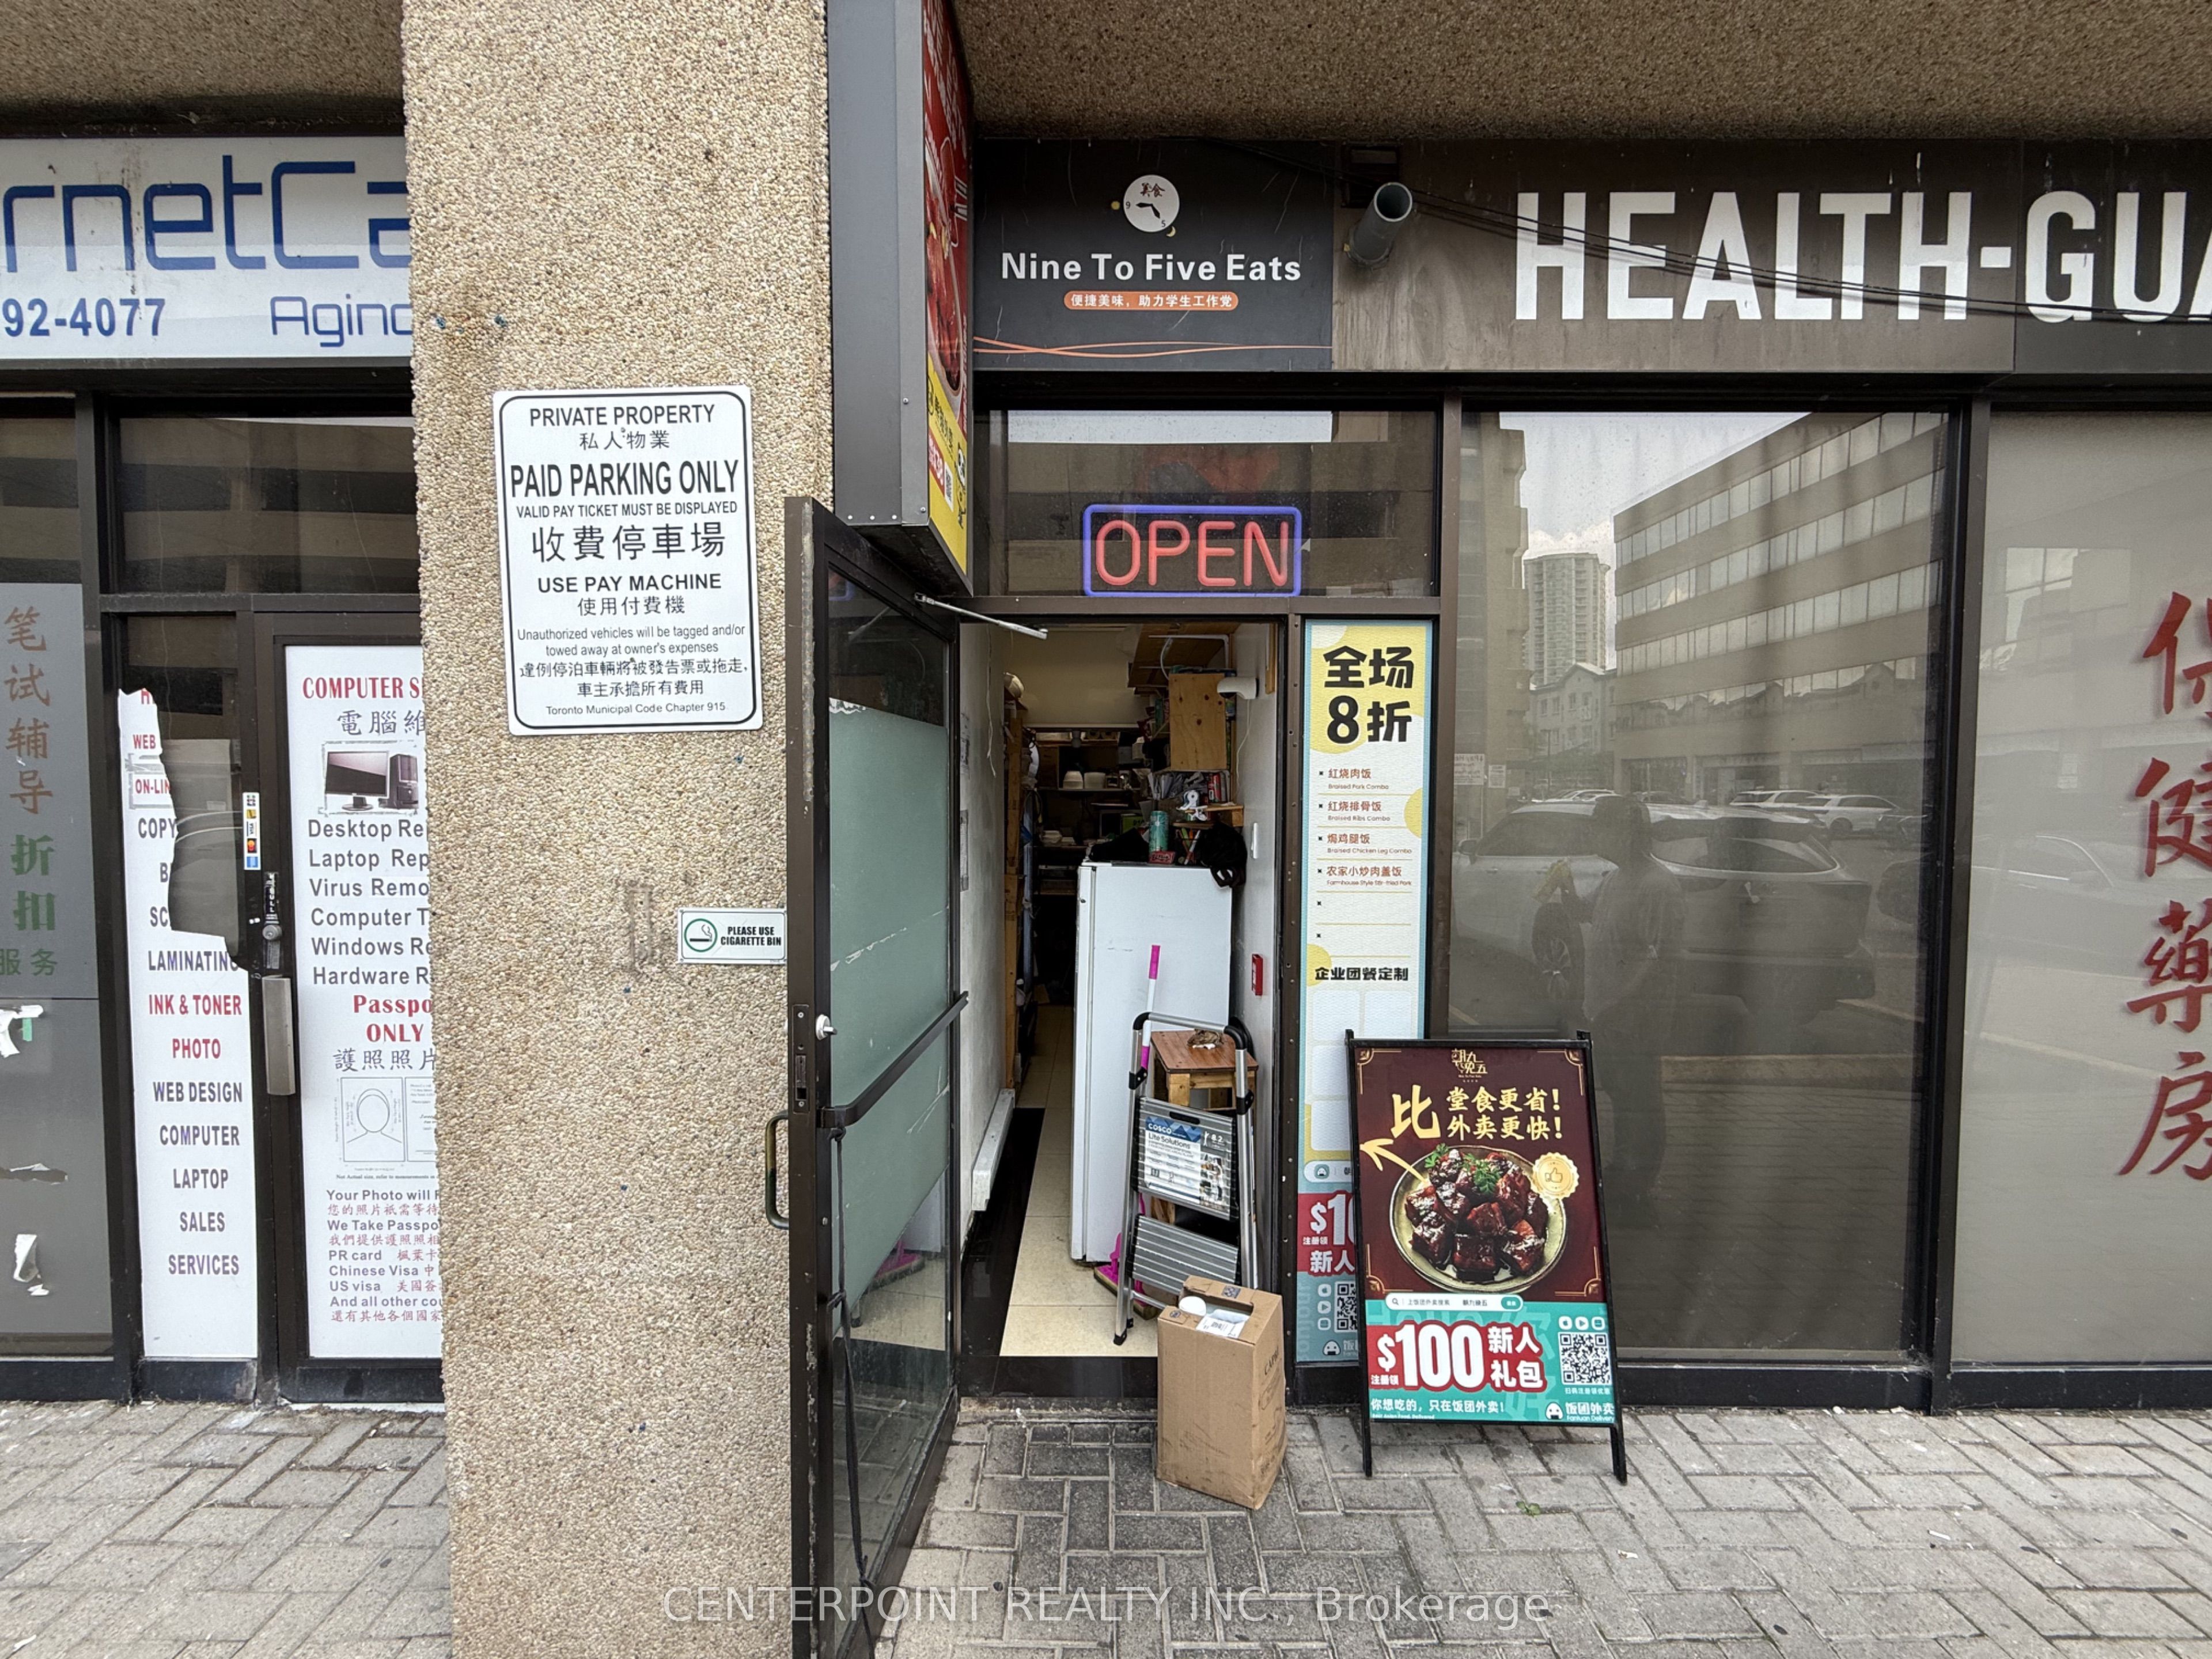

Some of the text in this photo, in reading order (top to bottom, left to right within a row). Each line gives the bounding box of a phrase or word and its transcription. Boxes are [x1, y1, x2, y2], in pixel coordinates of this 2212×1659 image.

[1125, 201, 1131, 209] 9
[1002, 252, 1301, 281] Nine To Five Eats
[1070, 294, 1232, 308] 便捷美味，助力学生工作党
[2, 298, 166, 336] 92-4077
[530, 404, 715, 427] PRIVATE PROPERTY
[579, 430, 670, 451] 私人物業
[511, 460, 738, 498] PAID PARKING ONLY
[516, 501, 737, 518] VALID PAY TICKET MUST BE DISPLAYED
[532, 521, 725, 563] 收費停車場
[1096, 519, 1289, 587] OPEN
[538, 573, 722, 593] USE PAY MACHINE
[577, 595, 685, 616] 使用付費機
[517, 623, 745, 641] Unauthorized vehicles will be tagged and/or
[546, 642, 719, 658] towed away at owner's expenses
[1323, 645, 1415, 688] 全场
[302, 677, 423, 699] COMPUTER S
[577, 680, 704, 699] 車主承擔所有費用
[546, 701, 726, 717] Toronto Municipal Code Chapter 915
[1327, 695, 1412, 744] 8折
[337, 709, 425, 736] 電腦維
[132, 734, 156, 749] WEB
[1328, 768, 1371, 779] 红烧肉饭
[1327, 801, 1382, 812] 红烧排骨饭
[138, 818, 177, 839] COPY
[308, 819, 392, 842] Desktop
[309, 849, 380, 872] Laptop
[1326, 865, 1402, 877] 农家小炒肉盖饭
[10, 834, 56, 931] 折扣
[309, 877, 430, 896] Virus Remo
[310, 907, 412, 930] Computer
[727, 926, 775, 935] PLEASE USE
[311, 937, 404, 956] Windows
[720, 937, 781, 946] CIGARETTE BIN
[313, 966, 410, 985] Hardware
[1315, 967, 1409, 982] 企业团餐定制
[148, 995, 243, 1016] INK & TONER
[353, 994, 432, 1018] Passpo
[366, 1023, 424, 1043] ONLY
[172, 1039, 221, 1059] PHOTO
[332, 1047, 437, 1073] 護照照片
[153, 1081, 243, 1103] WEB DESIGN
[1446, 1086, 1560, 1113] 堂食更省！
[1390, 1084, 1441, 1139] 比
[159, 1125, 240, 1146] COMPUTER
[1148, 1123, 1172, 1134] COSCO
[1446, 1113, 1563, 1141] 外卖更快！
[1148, 1132, 1160, 1141] Lite
[1161, 1135, 1191, 1149] Solutions
[173, 1168, 229, 1189] LAPTOP
[326, 1190, 358, 1201] Your
[362, 1189, 403, 1201] Photo
[406, 1190, 430, 1201] will
[179, 1211, 225, 1232] SALES
[327, 1219, 438, 1233] We Take Passpo
[168, 1254, 240, 1275] SERVICES
[328, 1249, 348, 1260] PR
[351, 1249, 382, 1261] card
[1309, 1249, 1355, 1273] 新人
[329, 1265, 385, 1277] Chinese
[388, 1265, 419, 1276] Visa
[329, 1279, 441, 1293] US visa 美國簽
[330, 1296, 418, 1307] And all other
[1487, 1326, 1540, 1354] 新人
[1377, 1324, 1485, 1388] $100
[1490, 1359, 1544, 1389] 礼包
[1370, 1398, 1504, 1413] 你想吃的，只在饭团外卖！
[1565, 1402, 1615, 1415] 饭团外卖
